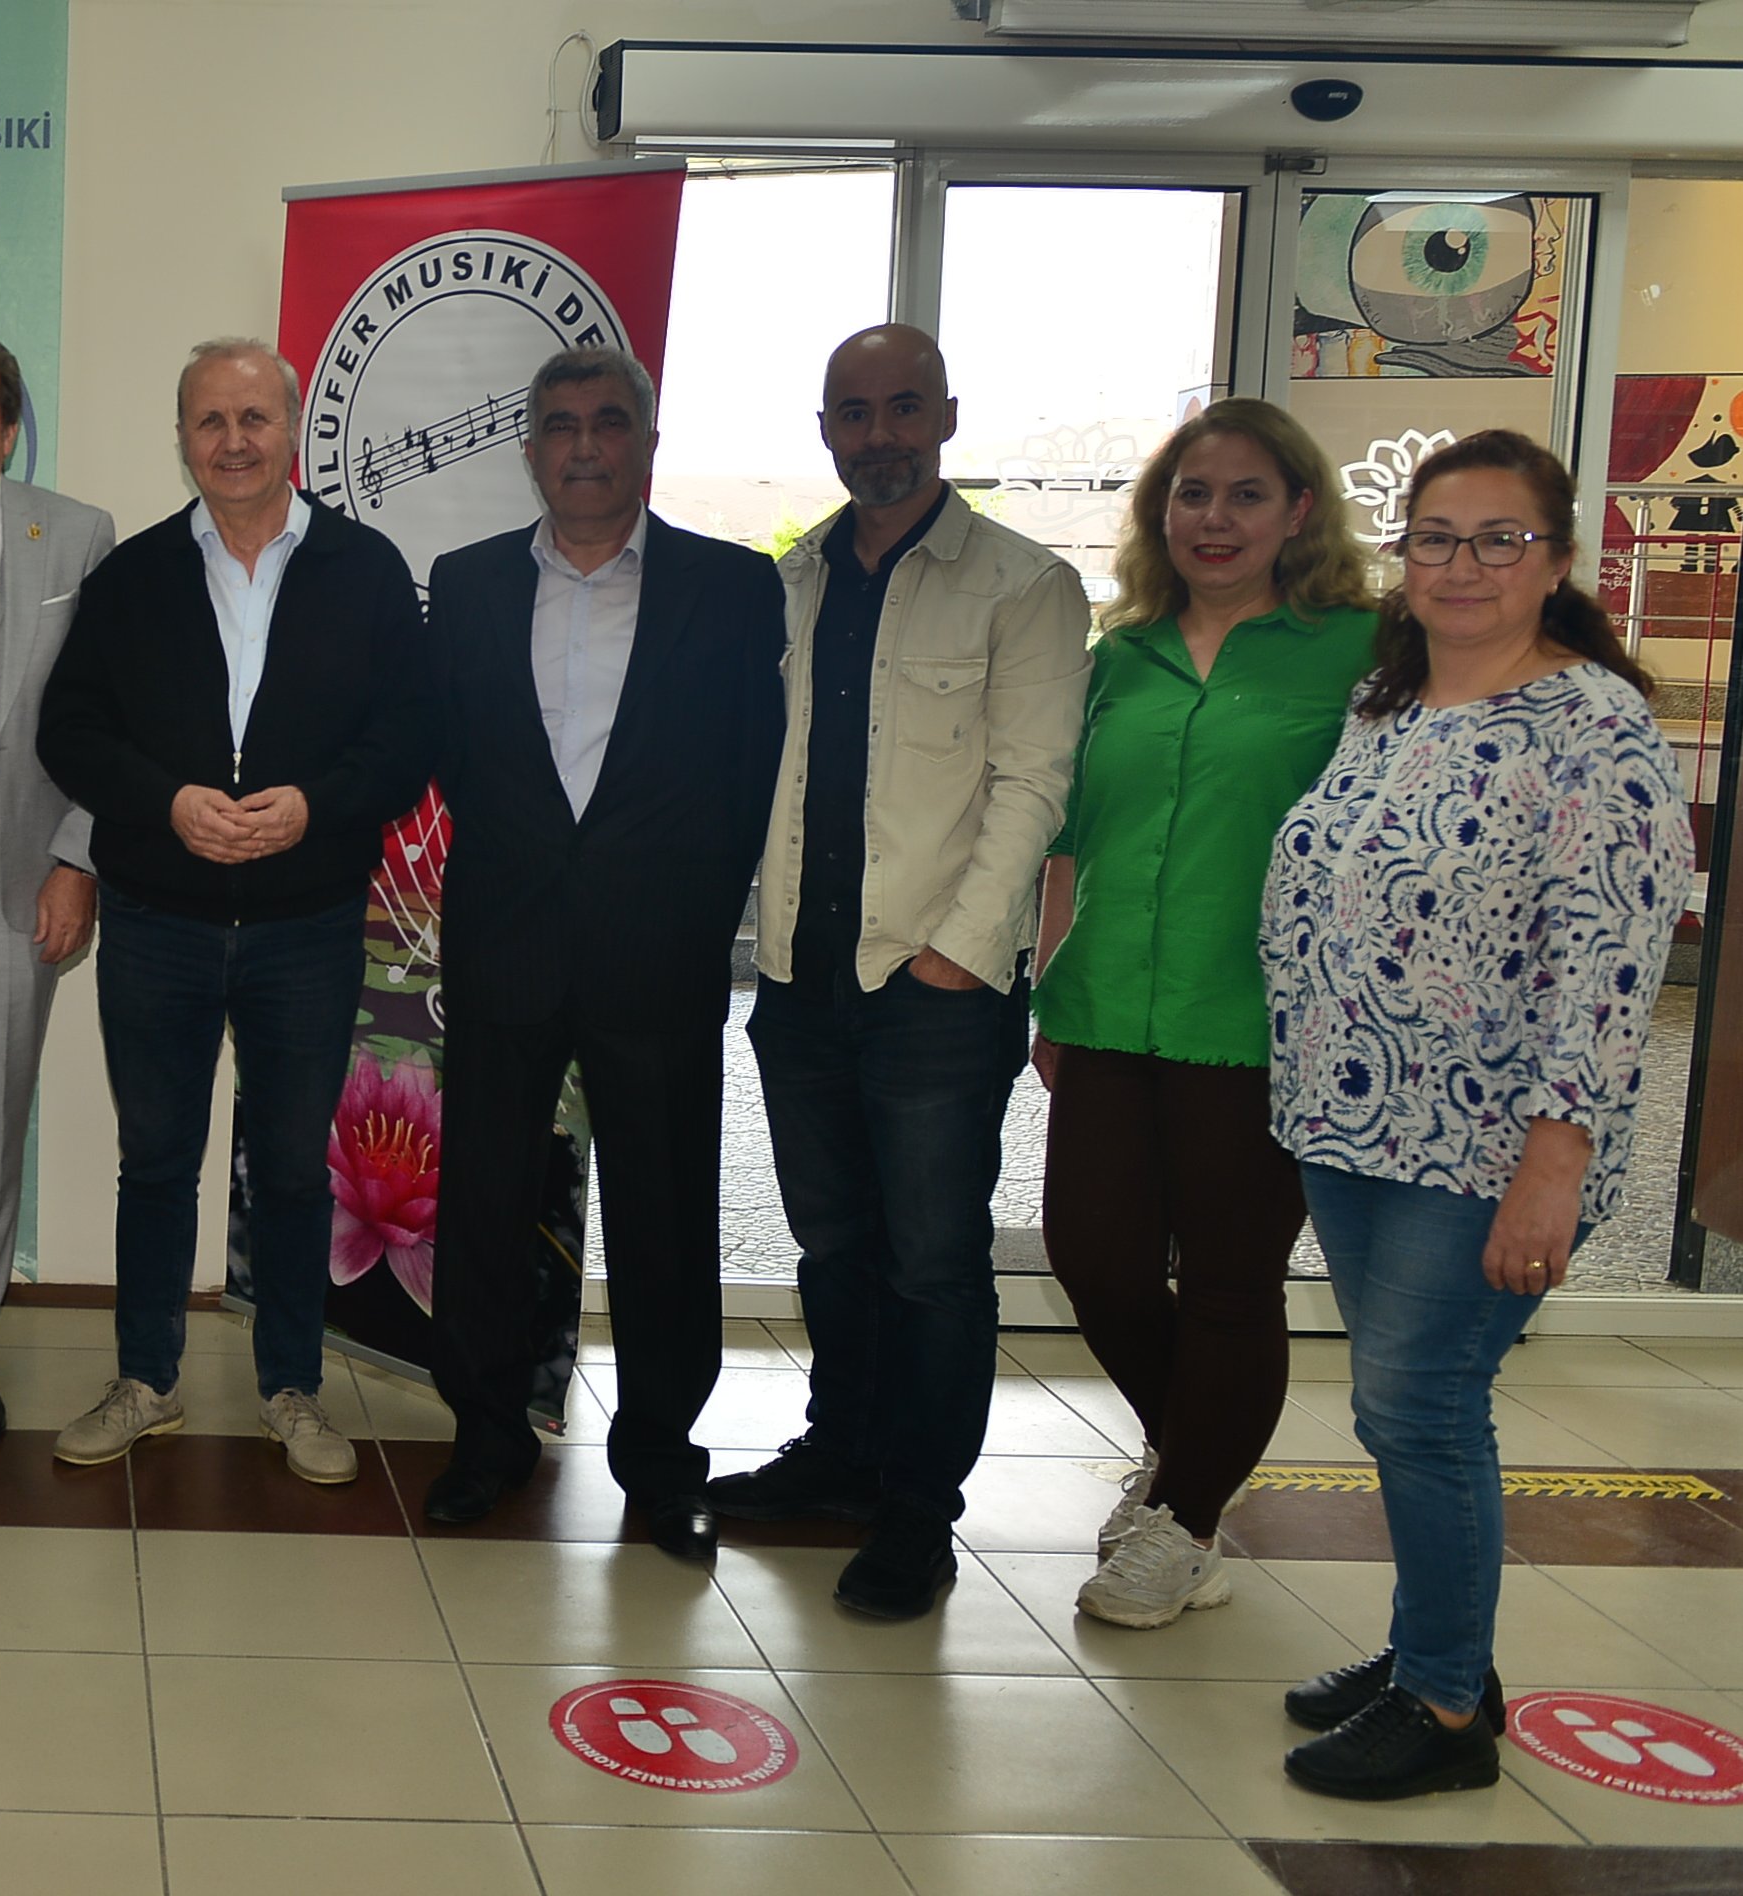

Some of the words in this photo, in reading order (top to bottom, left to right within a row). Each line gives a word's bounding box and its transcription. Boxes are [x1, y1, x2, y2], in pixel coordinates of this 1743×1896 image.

[383, 251, 552, 311] MUSIKİ
[1500, 1476, 1571, 1486] METR
[561, 1722, 621, 1771] KORUYUN
